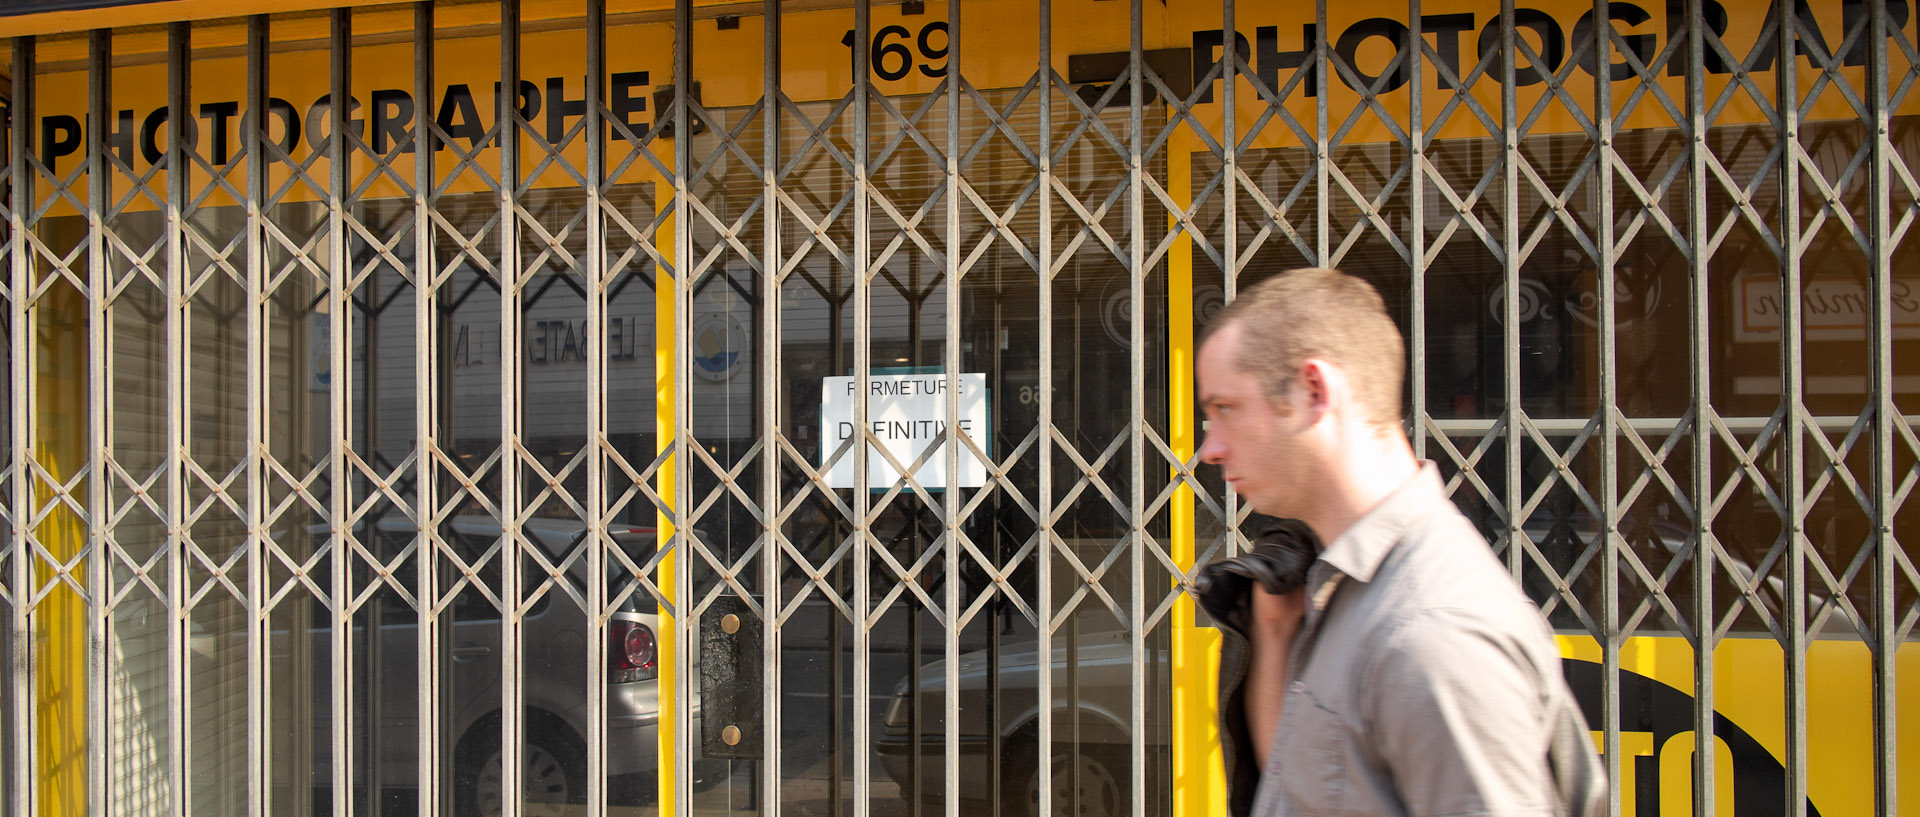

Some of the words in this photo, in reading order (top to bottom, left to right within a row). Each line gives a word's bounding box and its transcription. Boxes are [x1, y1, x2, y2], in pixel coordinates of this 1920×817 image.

[841, 21, 954, 85] 169
[1193, 0, 1920, 104] PHOTOGRAP
[42, 71, 650, 177] PHOTOGRAPHE
